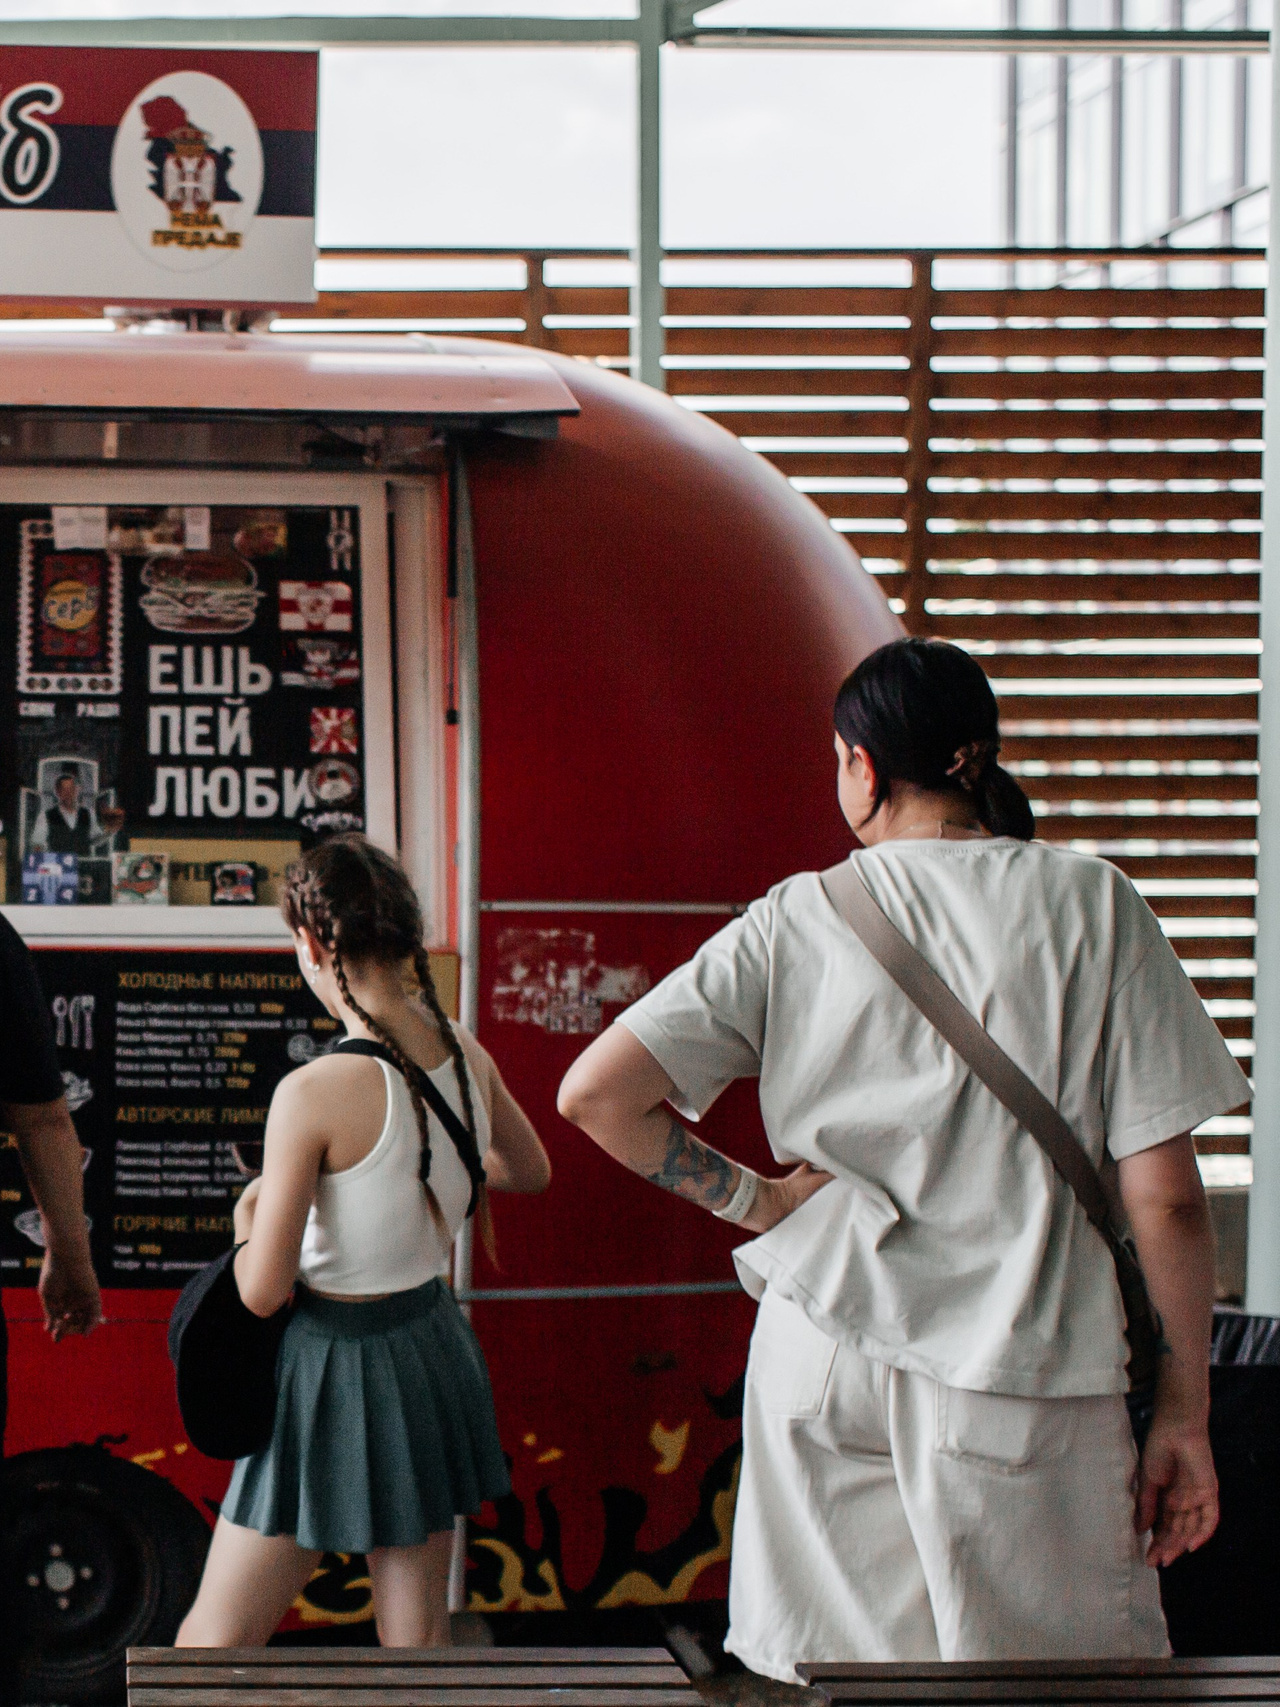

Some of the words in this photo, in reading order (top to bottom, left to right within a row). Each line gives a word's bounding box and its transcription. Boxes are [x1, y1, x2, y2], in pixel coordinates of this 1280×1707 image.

[148, 644, 272, 695] ЕШЬ
[148, 697, 252, 756] ПЕЙ
[148, 766, 316, 819] ЛЮБИ
[118, 971, 214, 991] ХОЛОДНЫЕ
[219, 972, 303, 990] НАПИТКИ
[116, 1106, 216, 1124] АВТОРСКИЕ
[114, 1215, 188, 1232] ГОРЯЧИЕ
